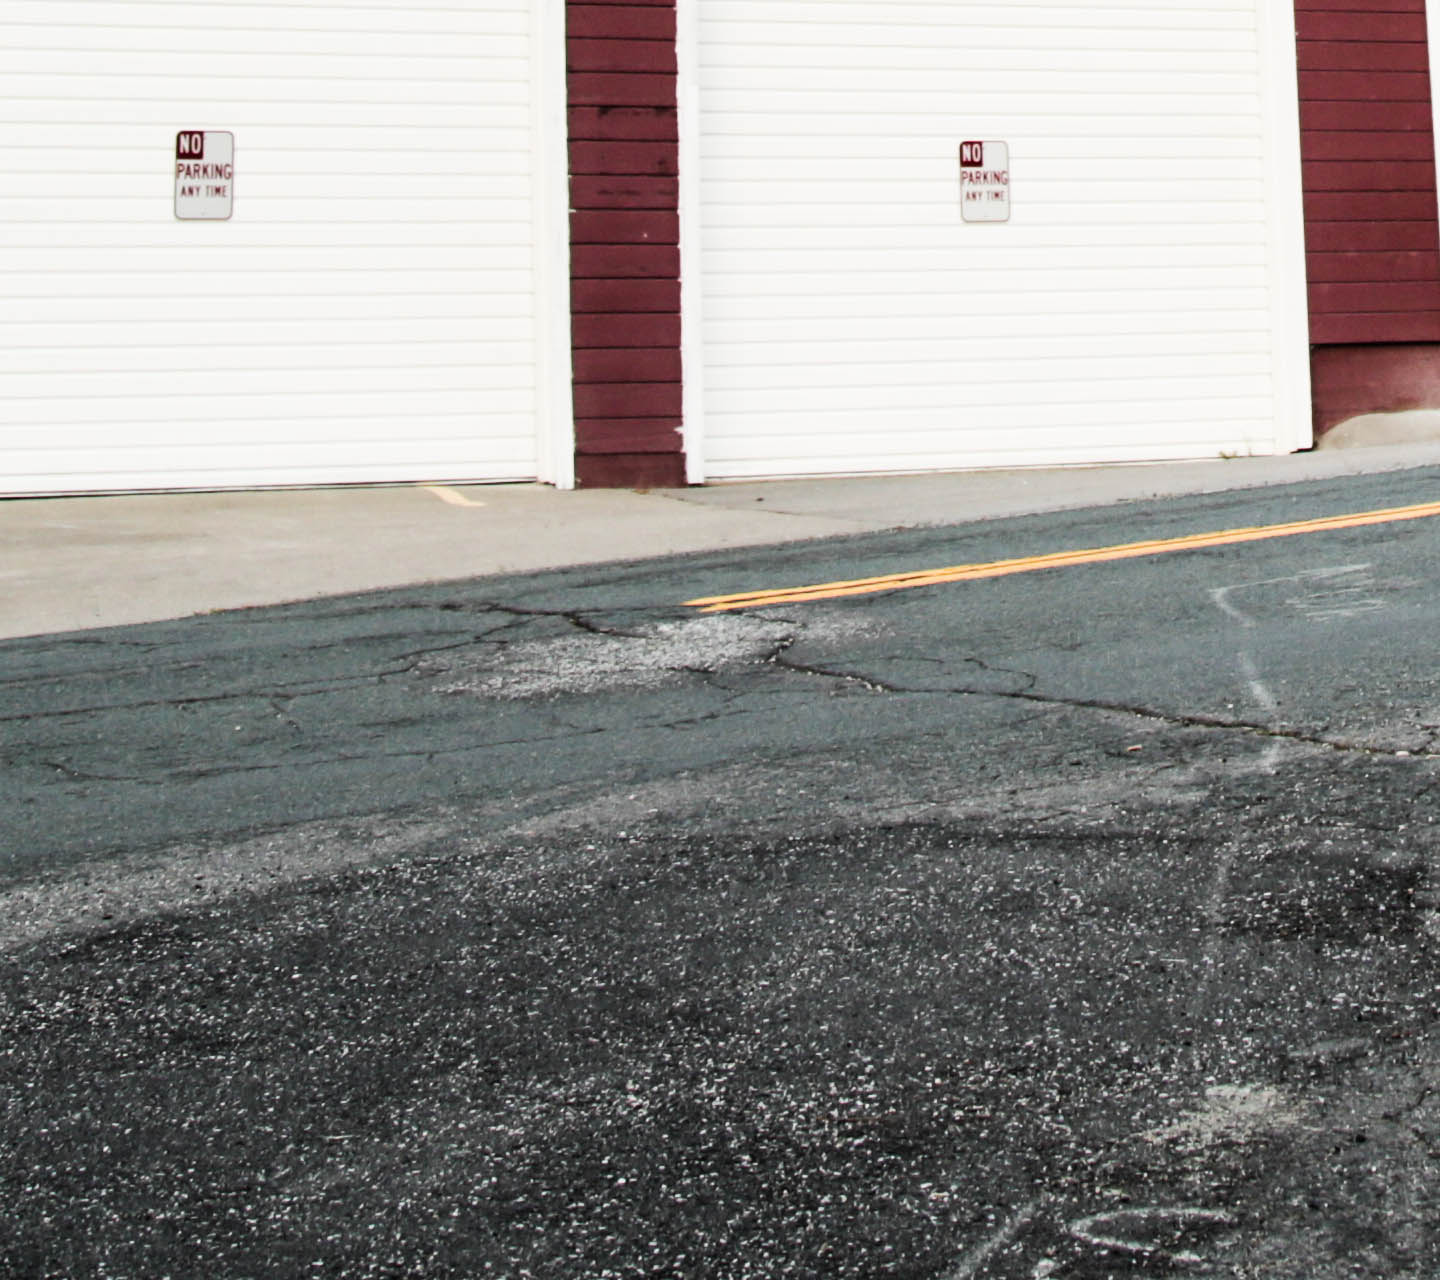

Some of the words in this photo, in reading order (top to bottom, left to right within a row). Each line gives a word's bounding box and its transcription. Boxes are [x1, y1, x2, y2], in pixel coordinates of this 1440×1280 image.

[180, 133, 201, 154] NO
[963, 143, 980, 161] NO
[176, 163, 232, 179] PARKING
[961, 170, 1008, 185] PARKING
[181, 185, 200, 197] ANY
[206, 185, 227, 197] TIME
[966, 191, 982, 200] ANY
[987, 191, 1005, 201] TIME
